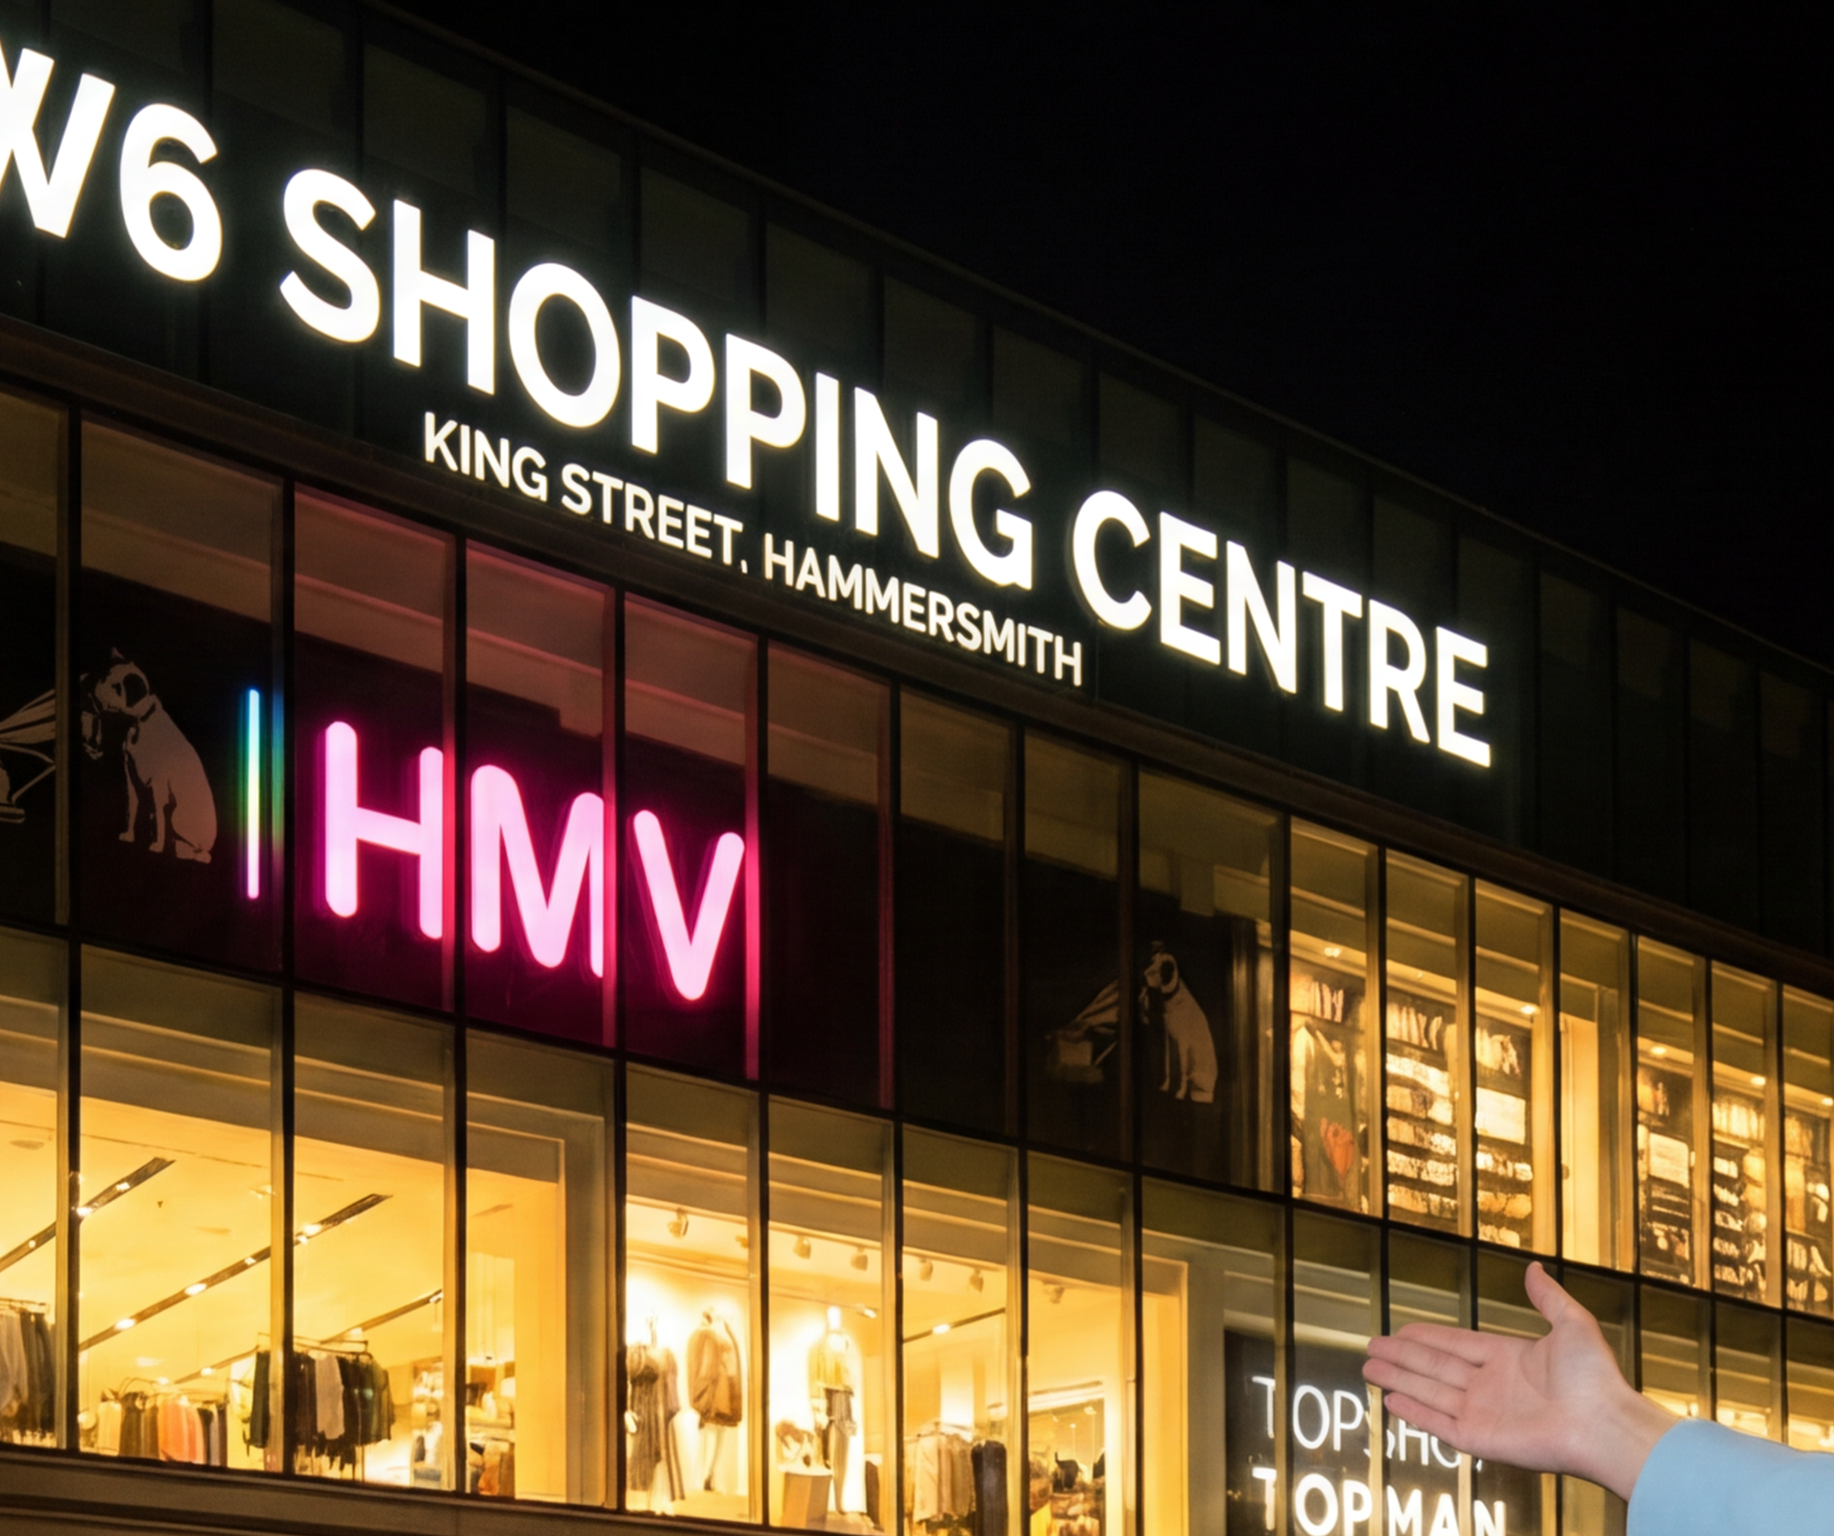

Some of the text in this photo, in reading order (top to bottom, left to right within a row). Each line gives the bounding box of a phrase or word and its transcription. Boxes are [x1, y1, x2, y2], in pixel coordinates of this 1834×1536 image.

[278, 167, 1033, 591] SHOPPING
[1072, 489, 1492, 768] CENTRE
[423, 410, 548, 502] KING
[764, 532, 1082, 687] HAMMERSMITH
[323, 719, 747, 1001] HMV
[1252, 1375, 1483, 1472] TOPH
